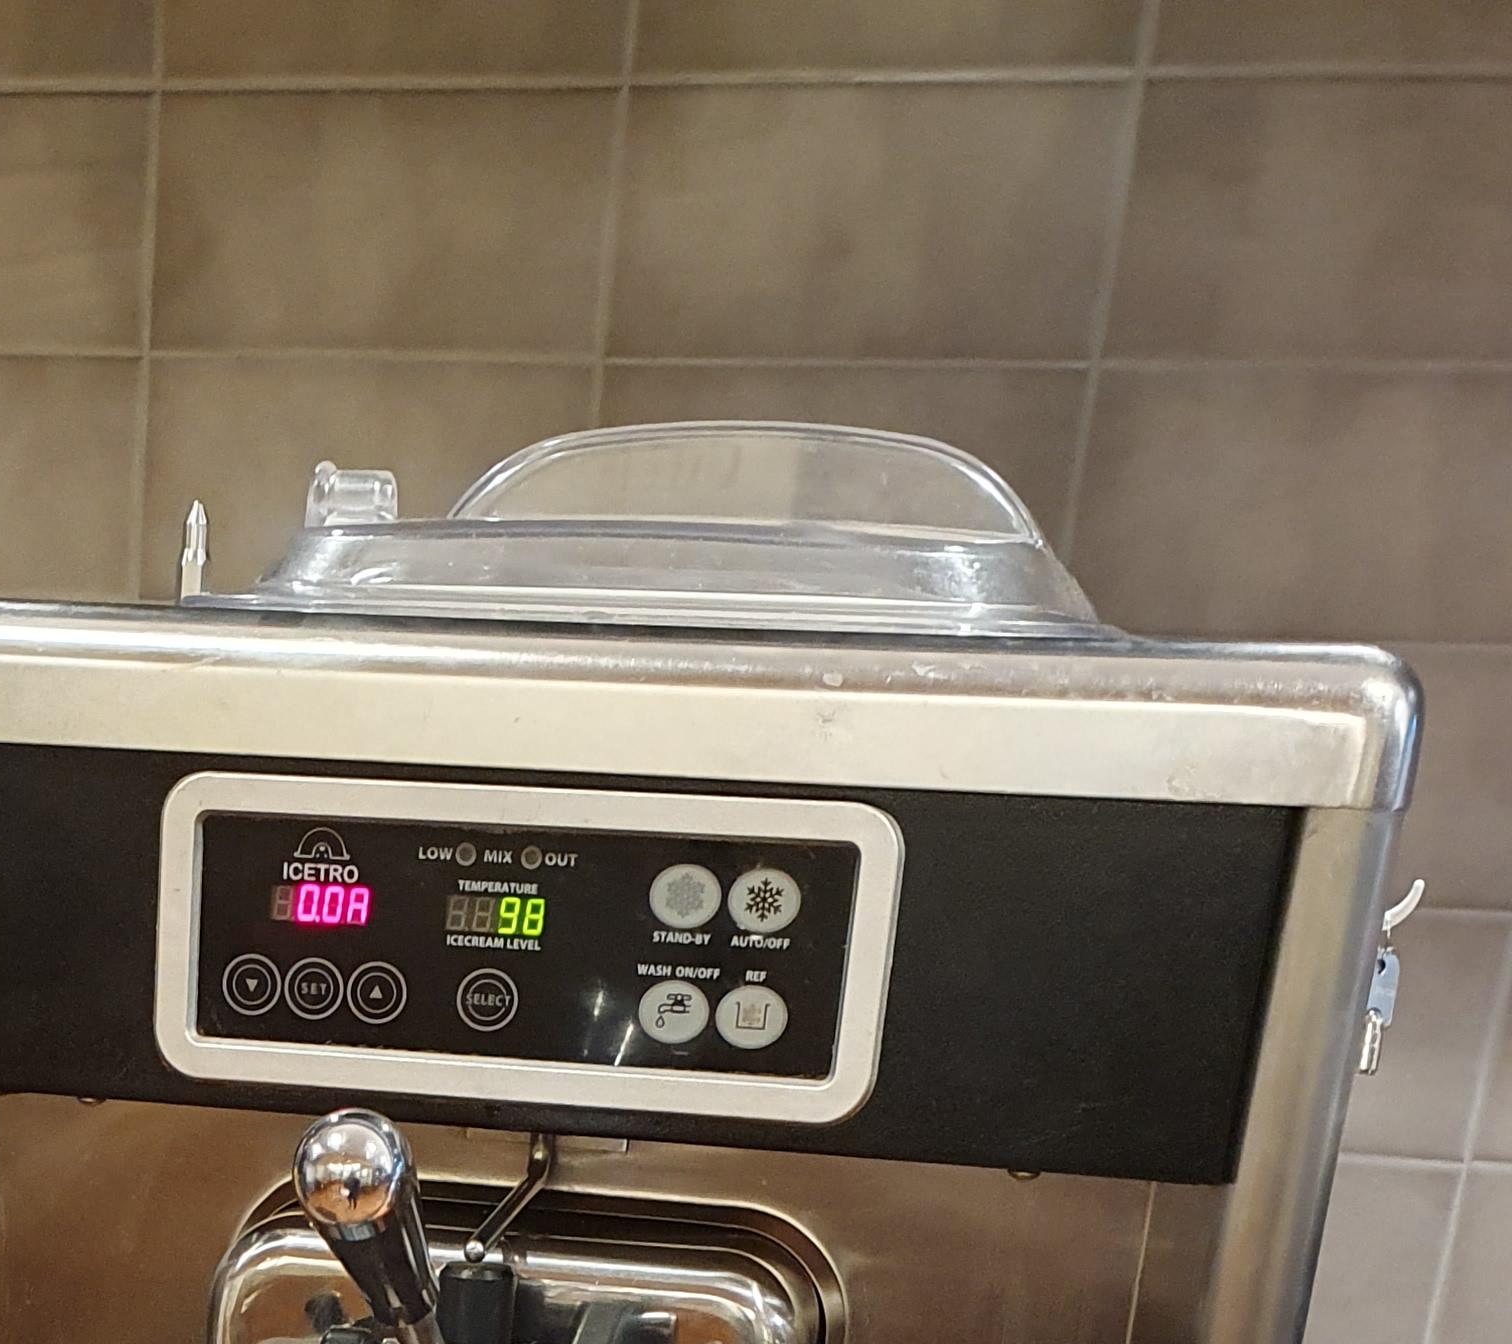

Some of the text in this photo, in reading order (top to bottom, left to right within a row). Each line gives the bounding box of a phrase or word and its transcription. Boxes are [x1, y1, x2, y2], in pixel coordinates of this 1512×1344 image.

[418, 847, 578, 868] LOW MIX OUT
[283, 862, 359, 883] ICETRO
[458, 879, 539, 895] TEMPERATURE
[498, 896, 546, 936] 98
[446, 934, 541, 951] ICECREAM LEVEL
[652, 931, 711, 946] STAND-BY
[731, 935, 791, 950] AUTO/OFF
[637, 963, 720, 981] WASH ON/OFF
[745, 970, 767, 982] REF
[300, 981, 328, 996] SET
[465, 993, 511, 1007] SELECT
